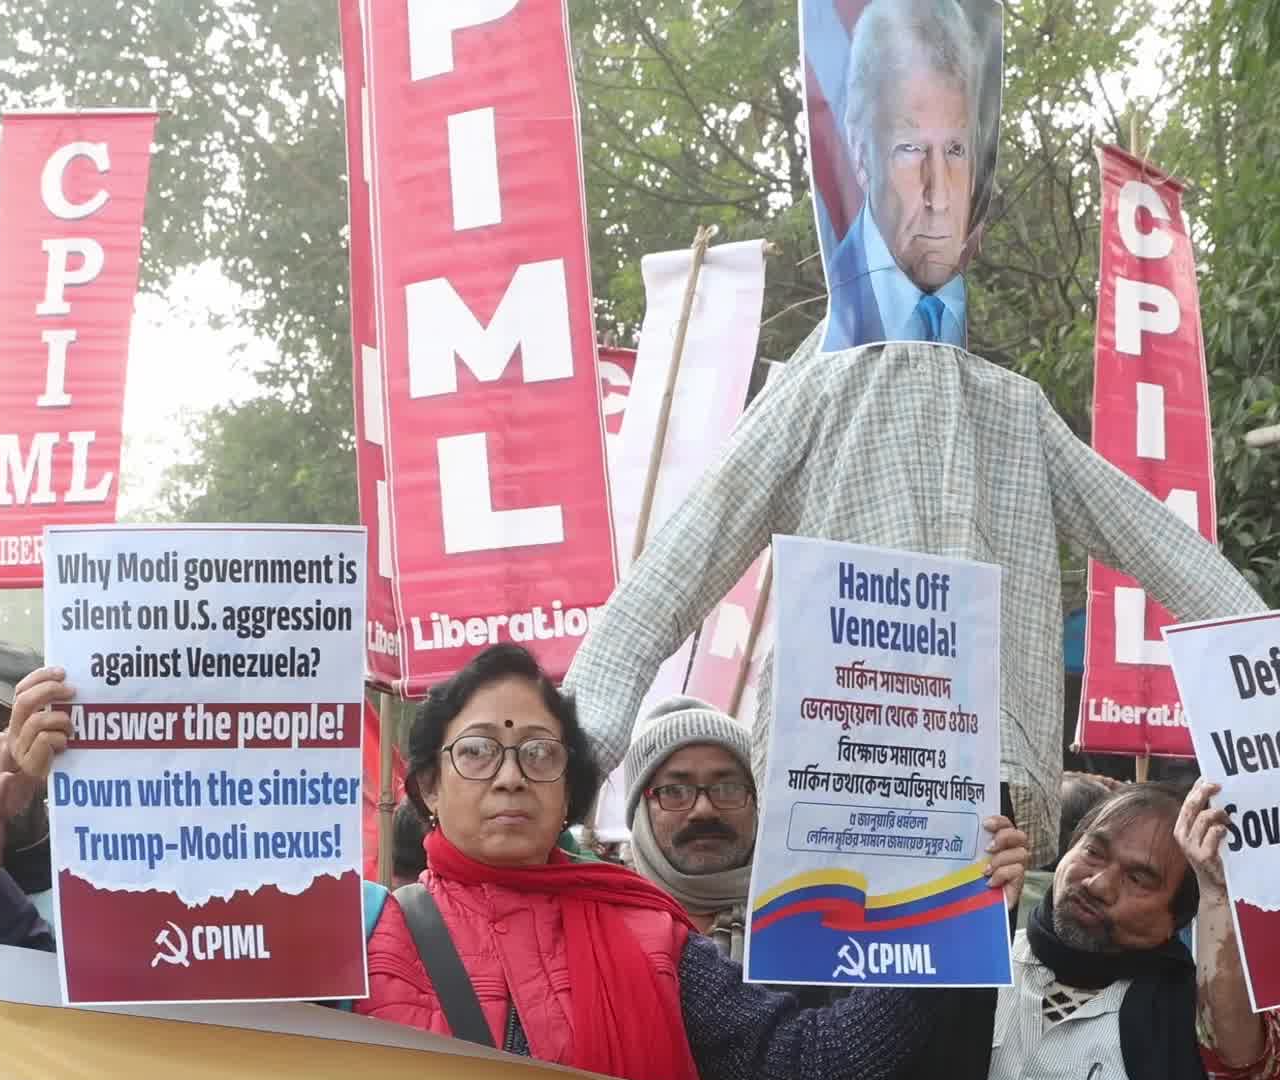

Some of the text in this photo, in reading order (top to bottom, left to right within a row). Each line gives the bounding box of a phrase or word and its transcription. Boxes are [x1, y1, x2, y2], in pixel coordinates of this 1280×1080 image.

[1114, 179, 1198, 666] CPIL
[57, 551, 357, 589] Why Modi government is
[839, 562, 950, 612] Hands Off
[61, 601, 352, 638] silent on U.S. aggression
[830, 606, 956, 658] Venezuela!
[91, 647, 321, 685] against Venezuela?
[835, 661, 952, 699] মার্কিন সাম্রাজ্যবাদ
[70, 705, 344, 749] Answer the people!
[801, 698, 979, 734] ভেনেজুয়েলা থেকে হাত ওঠাও
[838, 736, 946, 769] বিক্ষোভ সমাবেশ ও
[54, 771, 359, 807] Down with the sinister
[788, 763, 831, 791] মার্কিন
[893, 772, 948, 807] অভিমুখে
[950, 775, 985, 803] মিছিল
[254, 824, 341, 858] nexus!
[192, 925, 270, 961] CPIML
[868, 942, 936, 975] CPIML
